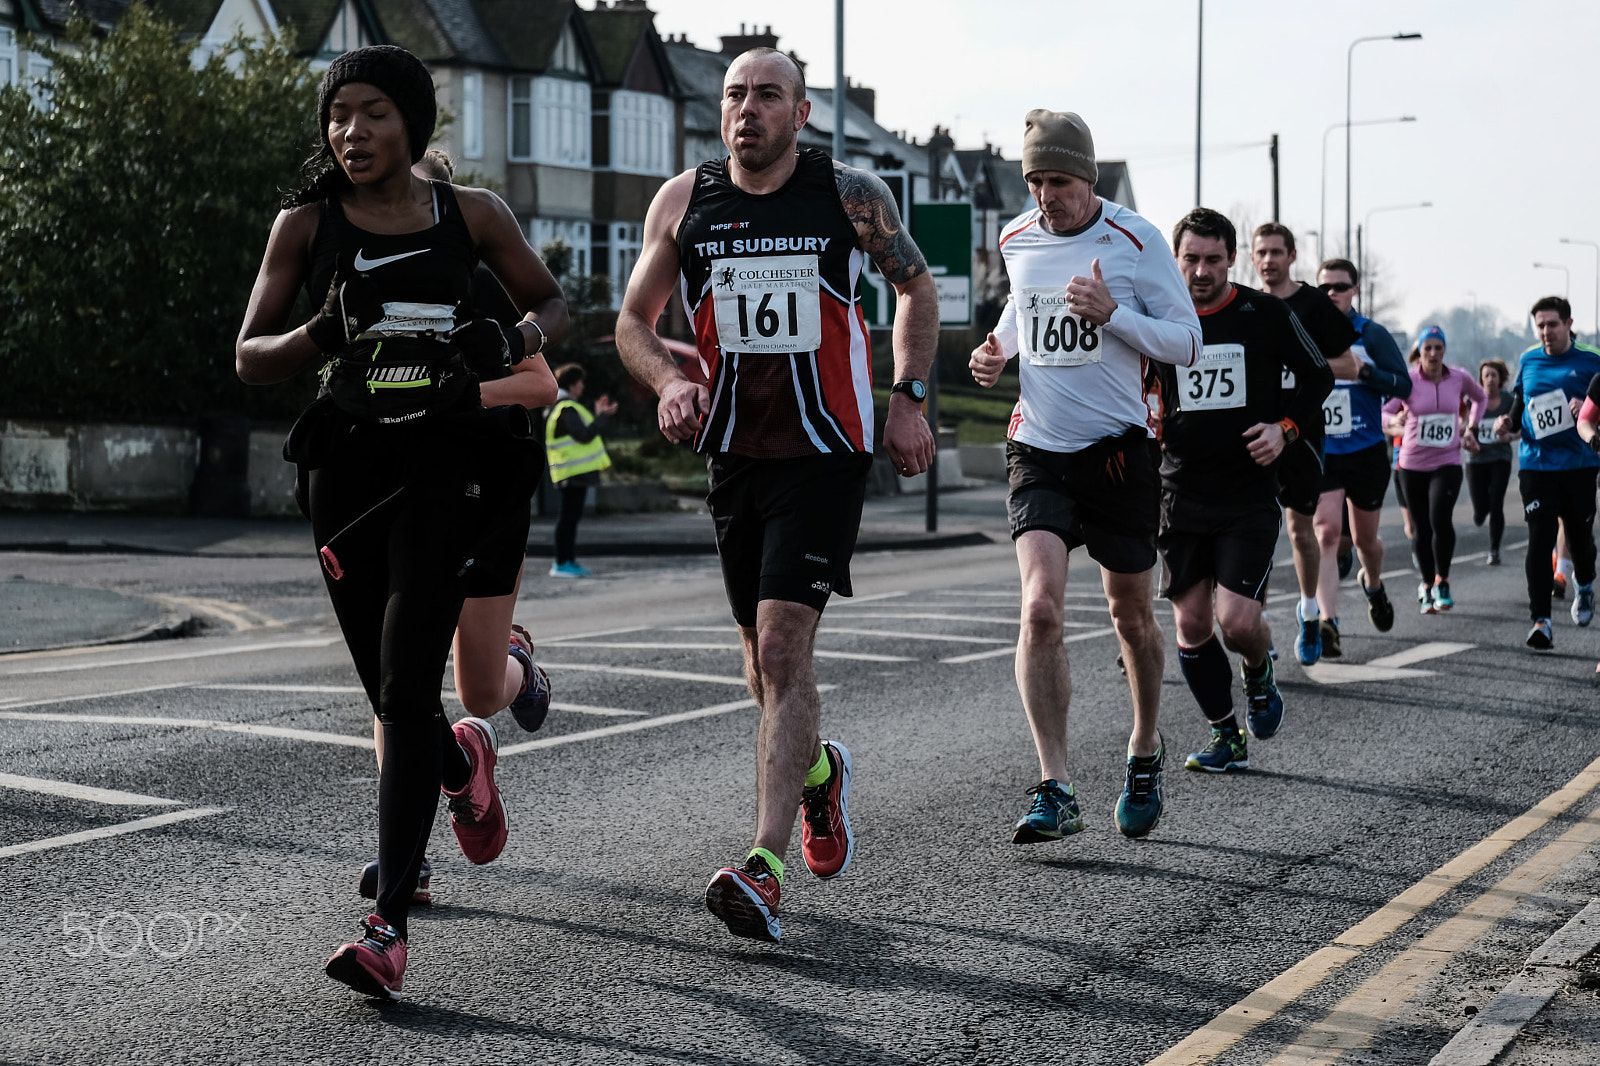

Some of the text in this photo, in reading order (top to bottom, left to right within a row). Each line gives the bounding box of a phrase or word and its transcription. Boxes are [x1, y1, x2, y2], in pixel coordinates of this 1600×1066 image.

[694, 237, 831, 257] TRI SUDBURY
[738, 268, 815, 280] COLCHESTER
[741, 281, 814, 290] HALF MARATHON
[737, 292, 798, 338] 161
[1032, 315, 1099, 352] 1608
[1201, 351, 1243, 360] LCHESTER
[1188, 368, 1235, 400] 375
[390, 409, 426, 423] karrimor
[1323, 406, 1343, 426] 05
[1536, 405, 1562, 430] 887
[1420, 420, 1453, 440] 1489
